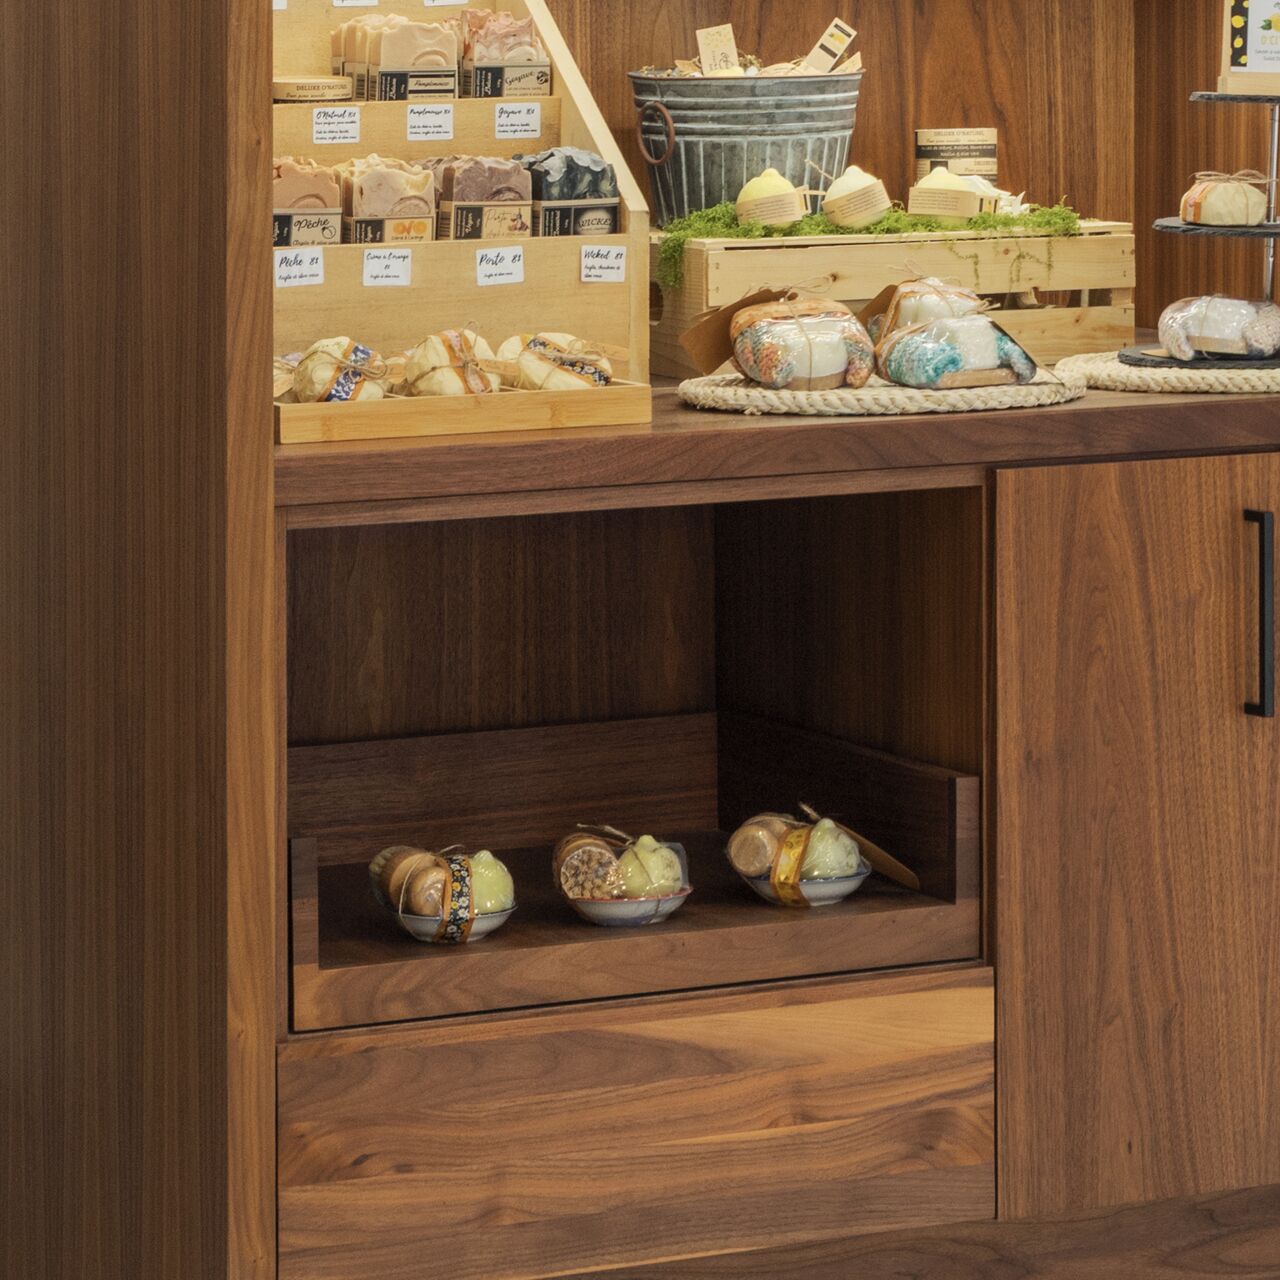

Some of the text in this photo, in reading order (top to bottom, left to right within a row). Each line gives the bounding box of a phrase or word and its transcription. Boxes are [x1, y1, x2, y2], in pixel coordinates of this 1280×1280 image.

[505, 70, 536, 86] Goyave
[293, 218, 330, 231] Pêche
[279, 254, 304, 268] Pêche
[479, 251, 505, 267] Porto
[583, 248, 610, 260] Wicked
